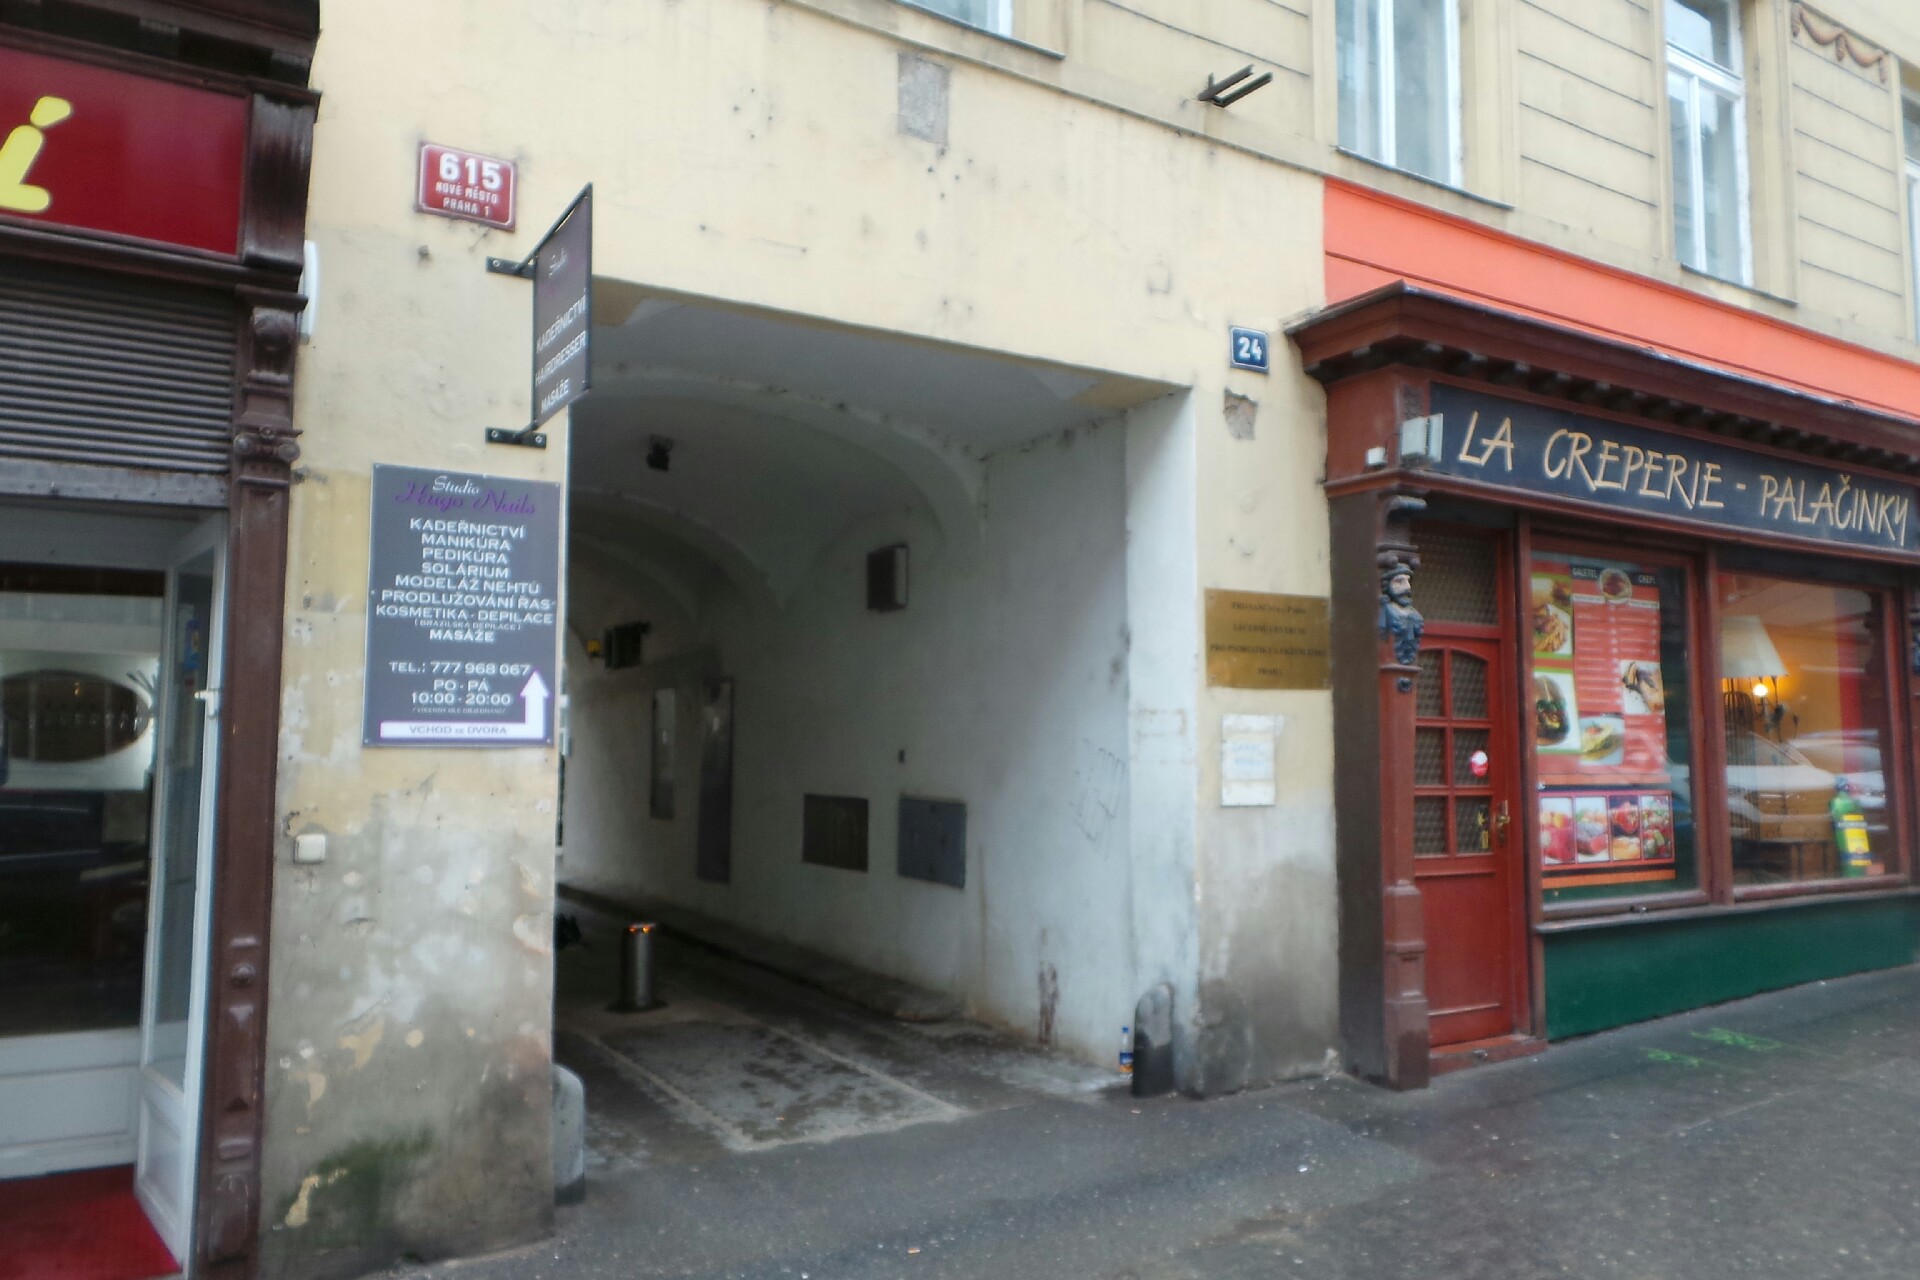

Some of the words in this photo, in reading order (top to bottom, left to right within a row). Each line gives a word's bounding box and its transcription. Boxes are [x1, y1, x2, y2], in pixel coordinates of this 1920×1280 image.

[439, 152, 502, 190] 615
[435, 181, 462, 195] NOVÉ
[465, 186, 498, 203] MĚSTO
[443, 197, 478, 214] PRAHA
[484, 206, 490, 216] 1
[1238, 337, 1263, 360] 24
[432, 475, 480, 494] Studio
[1459, 410, 1515, 471] LA
[1542, 428, 1725, 510] CREPERIE
[1760, 473, 1909, 547] PALAČINKY
[472, 489, 536, 515] Nails
[410, 518, 524, 538] KADEŘNICTVÍ
[421, 533, 511, 551] MANIKÚRA
[422, 547, 508, 564] PEDIKÚRA
[421, 562, 509, 579] SOLÁRIUM
[395, 574, 480, 591] MODELÁŽ
[382, 589, 514, 609] PRODLUŽOVÁNÍ
[517, 594, 550, 610] ŘAS
[376, 604, 467, 620] KOSMETIKA
[478, 610, 553, 624] DEPILACE
[429, 628, 494, 642] MASÁŽE
[389, 661, 426, 673] TEL.:
[430, 661, 462, 674] 777
[465, 662, 496, 675] 968
[499, 663, 531, 676] 067
[433, 679, 456, 692] PO
[467, 678, 489, 692] PÁ
[411, 692, 455, 705] 10:00
[465, 692, 512, 706] 20:00
[409, 725, 452, 734] VCHOD
[467, 726, 507, 735] DVORA
